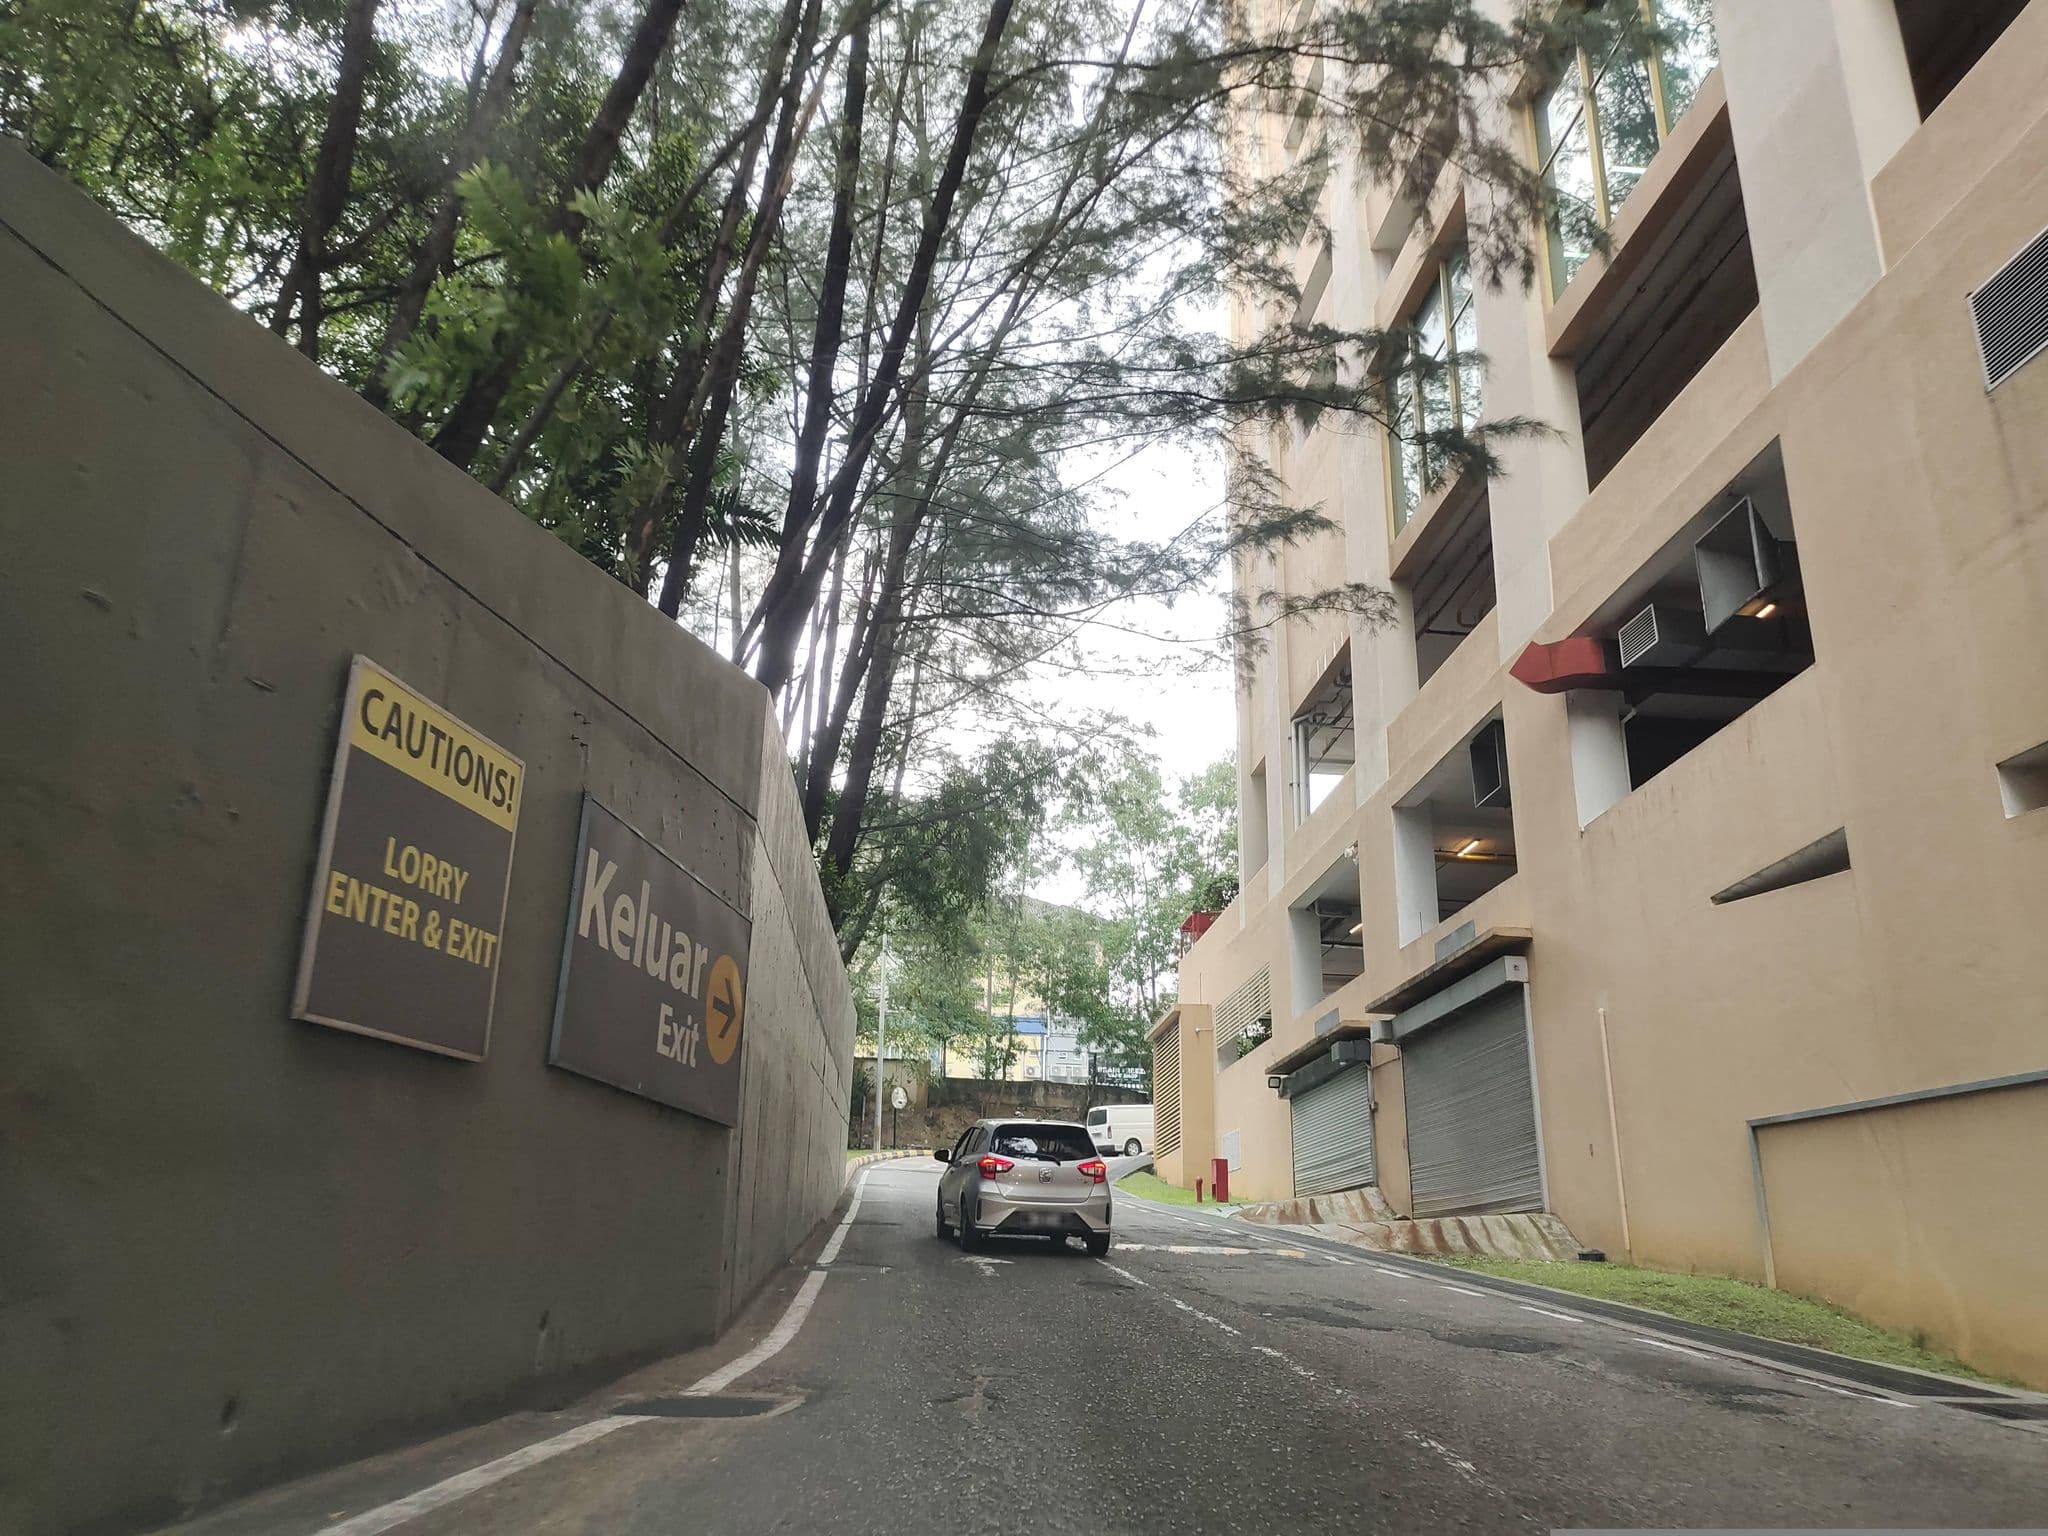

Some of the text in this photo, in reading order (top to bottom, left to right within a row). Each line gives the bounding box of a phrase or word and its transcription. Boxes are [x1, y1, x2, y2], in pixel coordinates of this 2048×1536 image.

[361, 689, 517, 813] CAUTIONS!
[327, 870, 498, 969] ENTER & EXIT
[384, 837, 469, 905] LORRY
[578, 848, 708, 1000] Keluar
[656, 1002, 700, 1068] Exit
